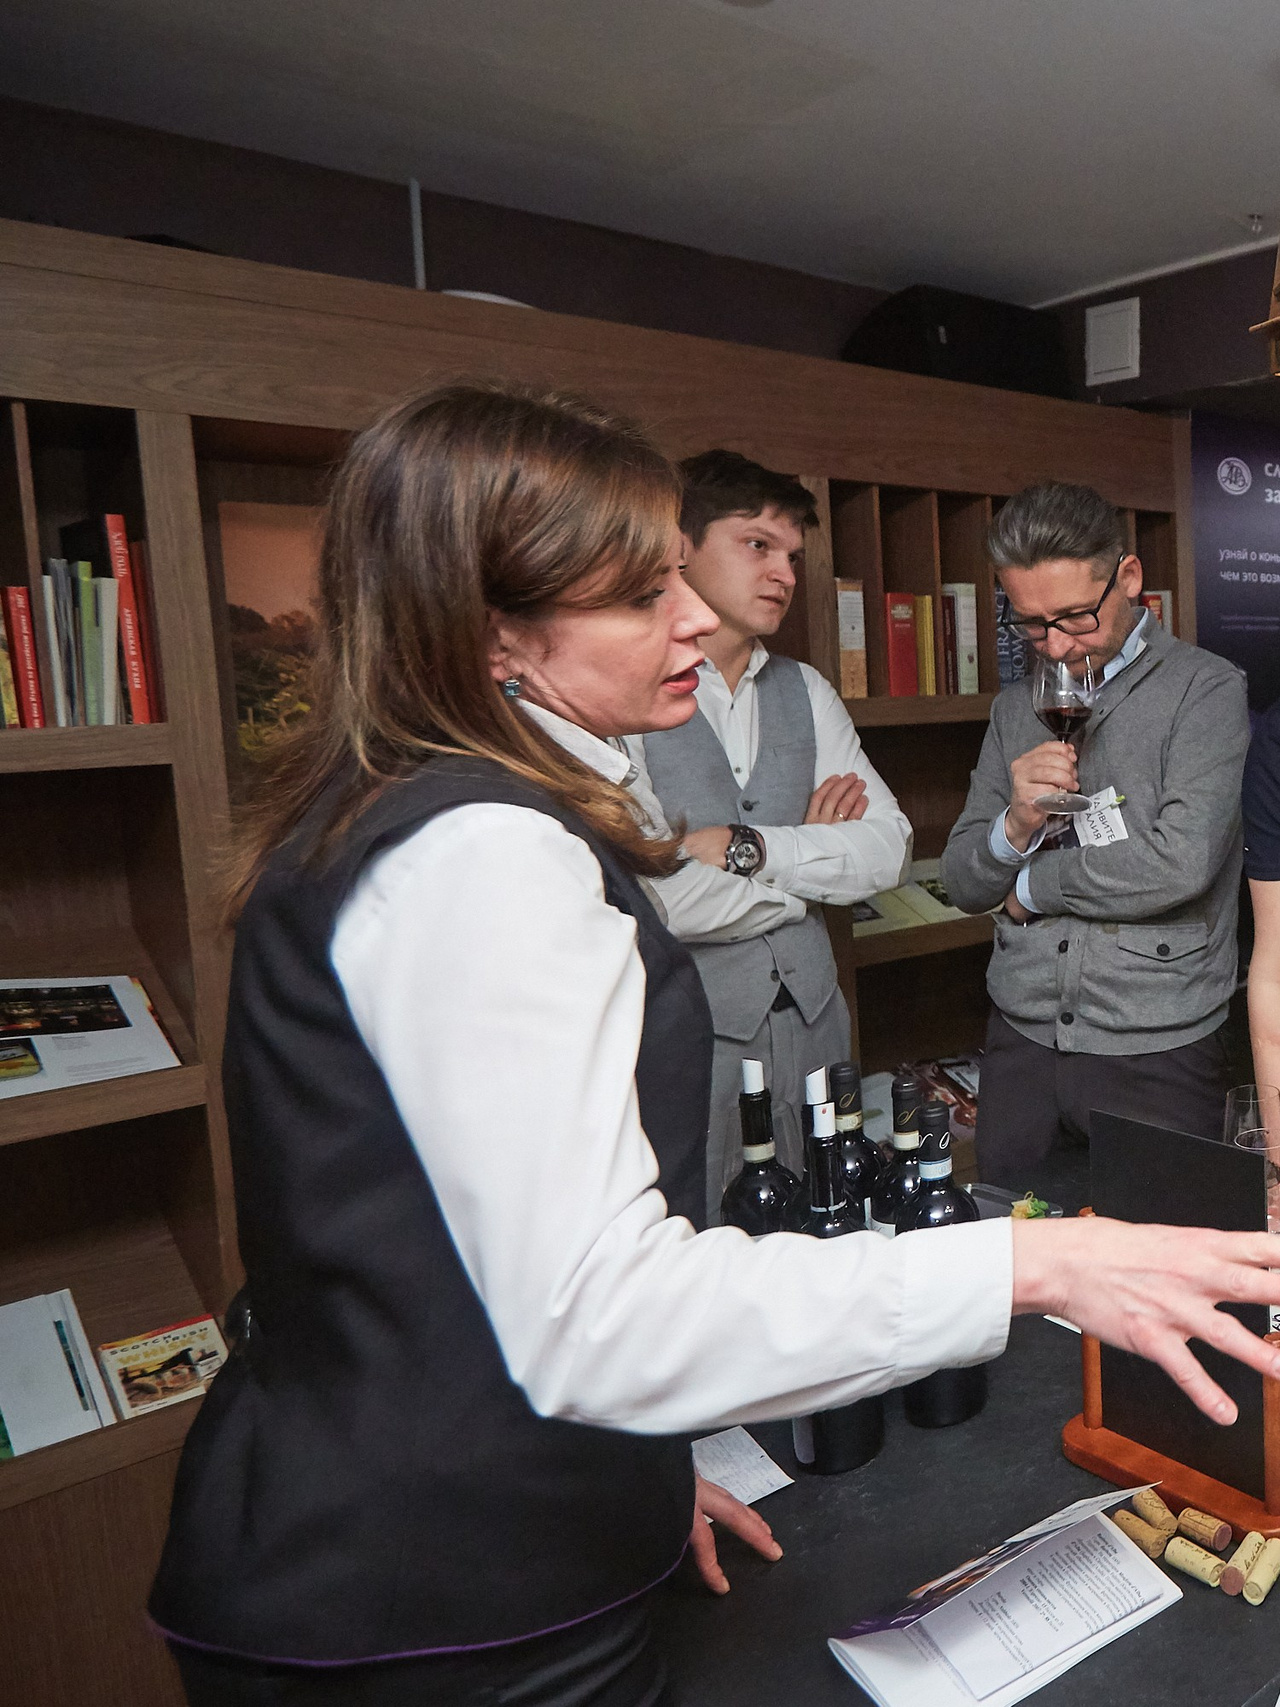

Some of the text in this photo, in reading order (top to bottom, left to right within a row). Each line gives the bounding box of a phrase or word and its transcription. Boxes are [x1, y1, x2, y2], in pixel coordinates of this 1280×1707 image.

[1219, 548, 1248, 562] узнай
[1250, 551, 1257, 561] о
[1220, 571, 1240, 582] чем
[1242, 572, 1258, 583] это
[165, 1327, 208, 1344] IRISH
[109, 1335, 172, 1356] SCOTCH
[117, 1332, 208, 1365] WHISKY
